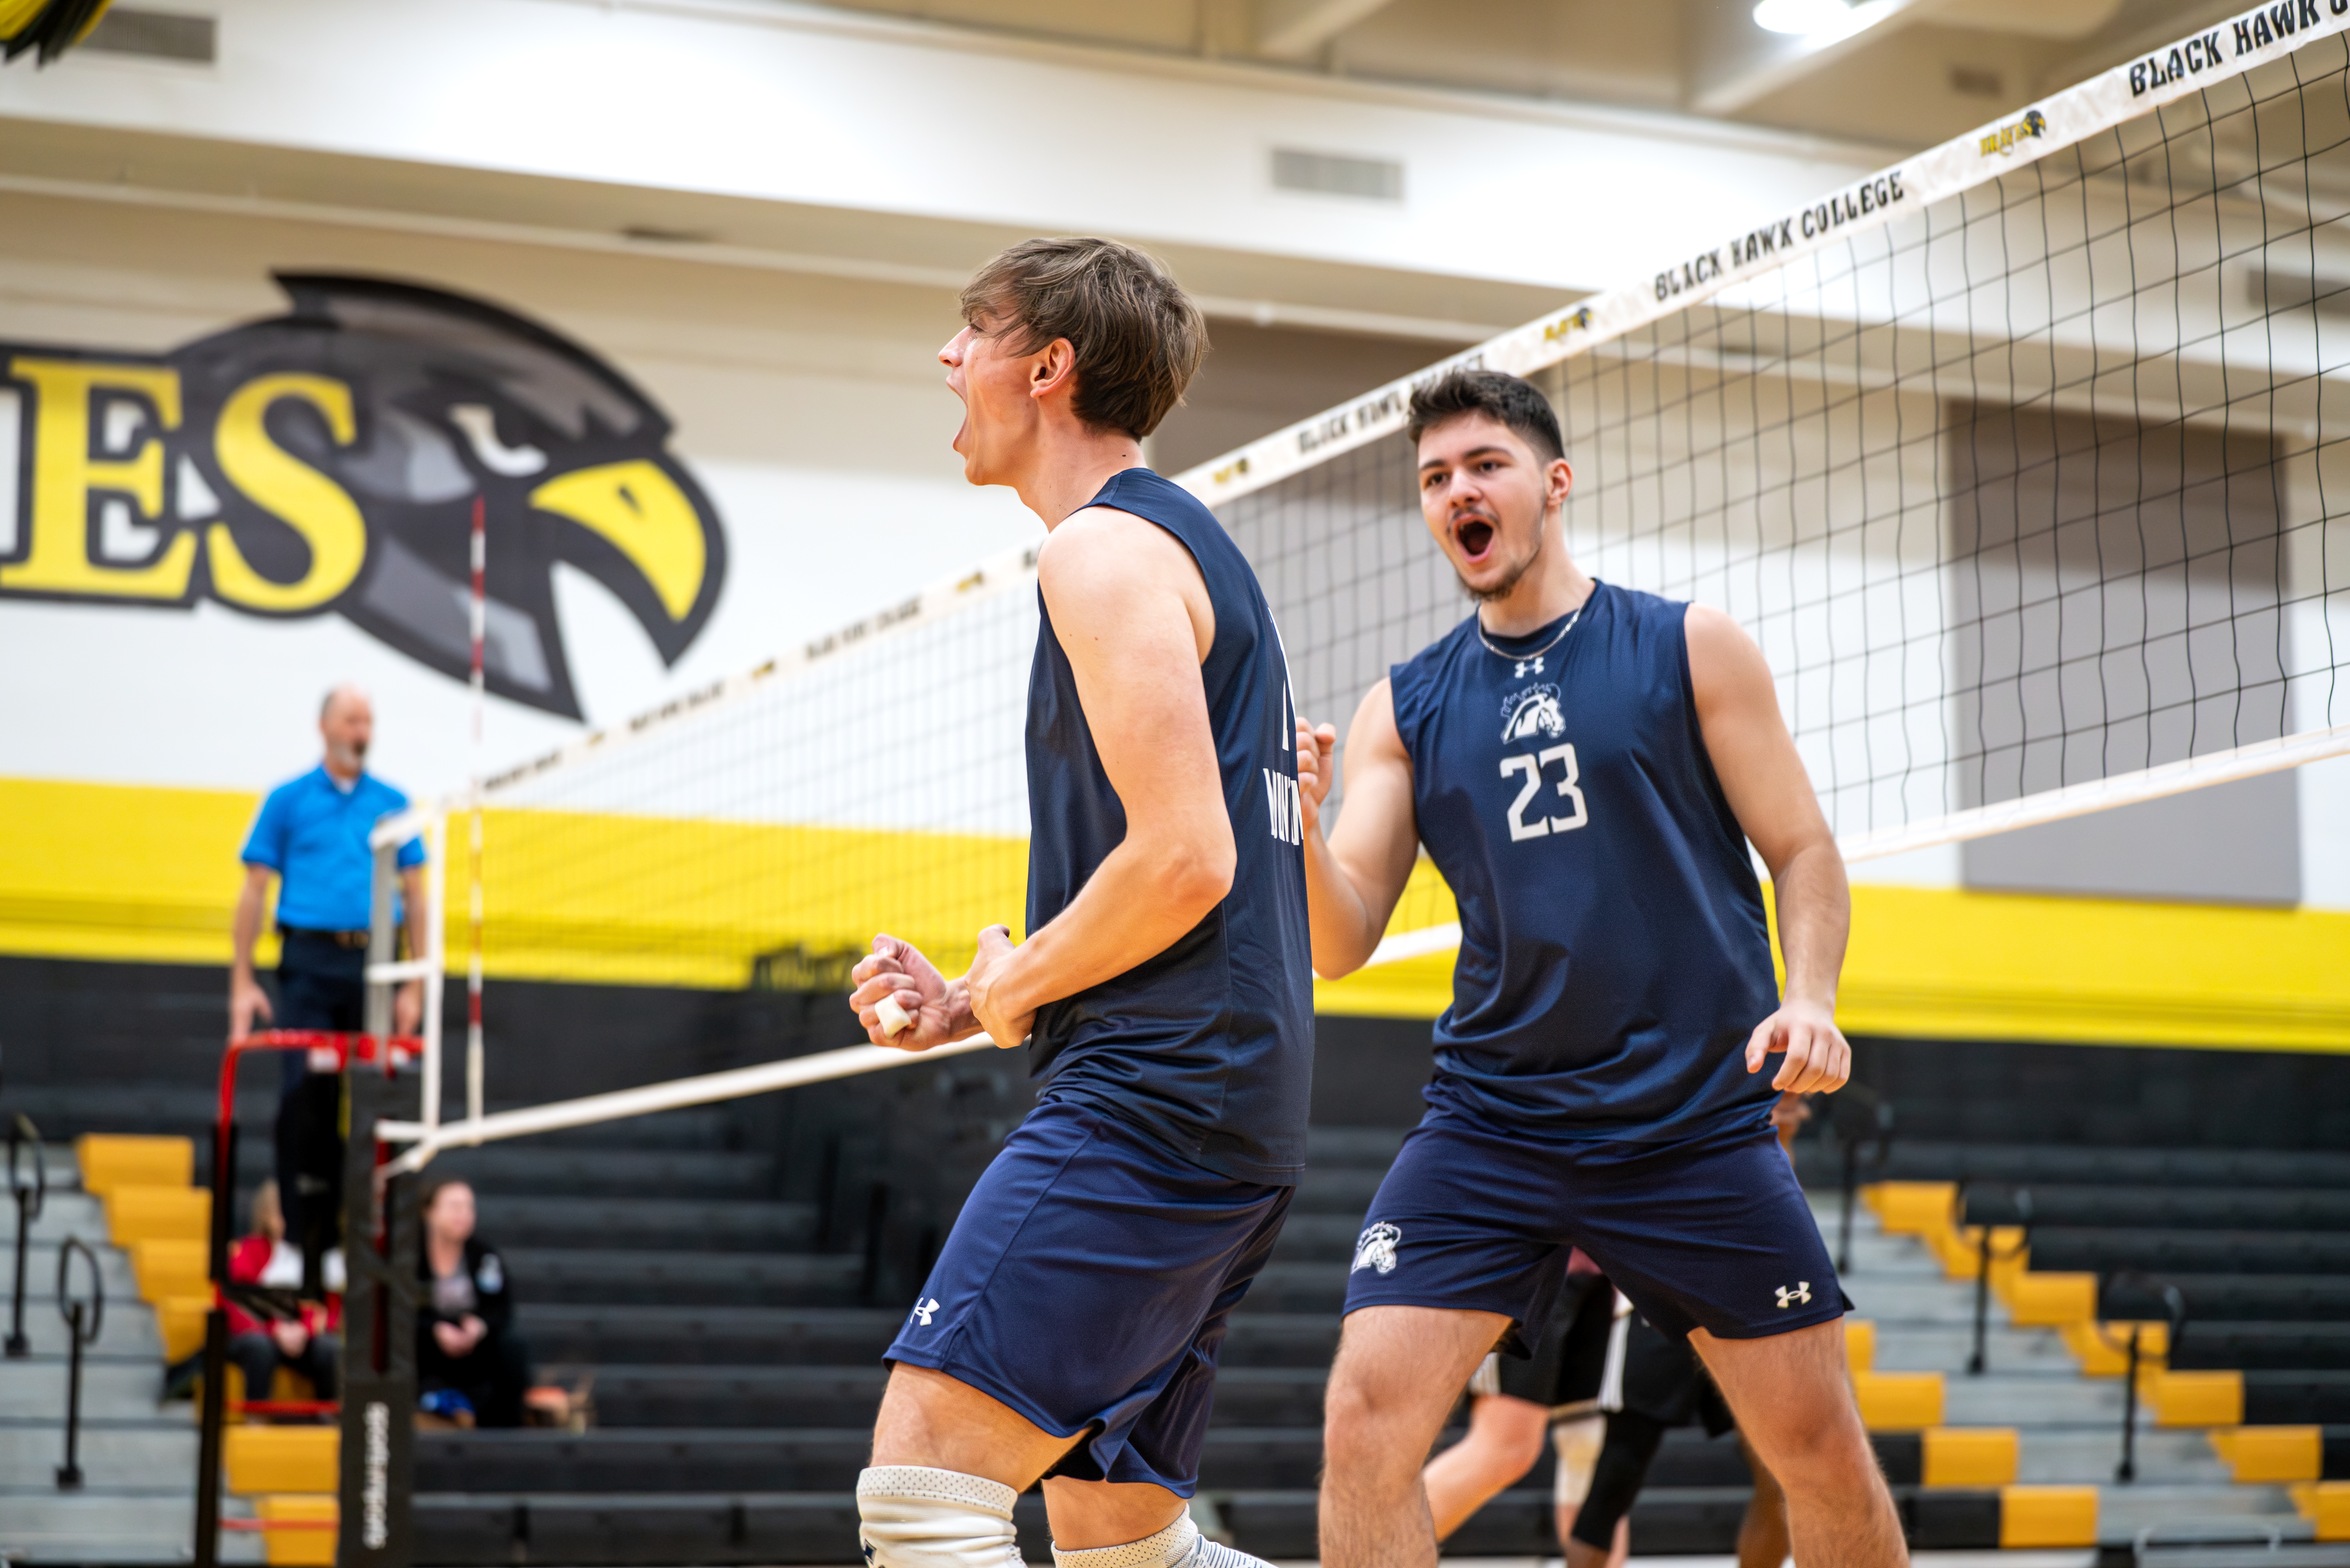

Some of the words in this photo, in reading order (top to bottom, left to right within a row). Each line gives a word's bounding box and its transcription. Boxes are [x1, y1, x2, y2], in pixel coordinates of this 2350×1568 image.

[2130, 31, 2222, 98] BLACK
[2233, 0, 2320, 57] HAWK
[1654, 248, 1723, 302] BLACK
[1730, 217, 1793, 269] HAWK
[1801, 170, 1904, 239] COLLEGE
[1499, 742, 1589, 843] 23
